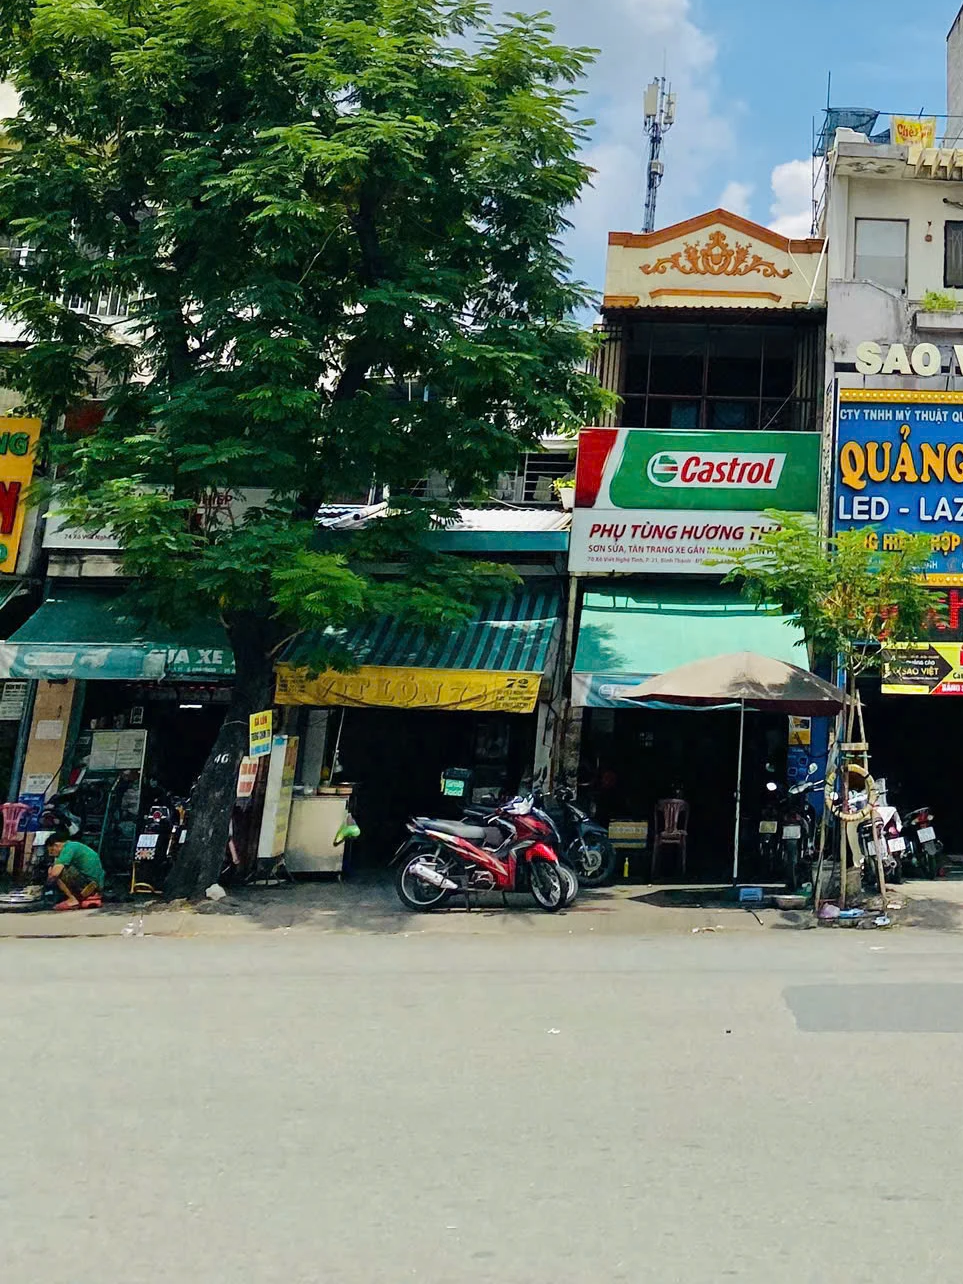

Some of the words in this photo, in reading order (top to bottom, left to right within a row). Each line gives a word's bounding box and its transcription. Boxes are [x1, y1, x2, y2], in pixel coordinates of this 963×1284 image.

[855, 341, 941, 376] SAO
[840, 409, 860, 420] CTY
[864, 409, 892, 421] TNHH
[896, 407, 912, 421] MỸ
[915, 408, 949, 423] THUẬT
[680, 456, 775, 485] Castrol
[838, 496, 890, 520] LED
[589, 523, 627, 543] PHỤ
[631, 521, 676, 540] TÙNG
[680, 522, 744, 540] HƯƠNG
[588, 544, 606, 552] SƠN
[646, 545, 674, 554] TRANG
[676, 546, 686, 554] XE
[195, 649, 224, 664] XE
